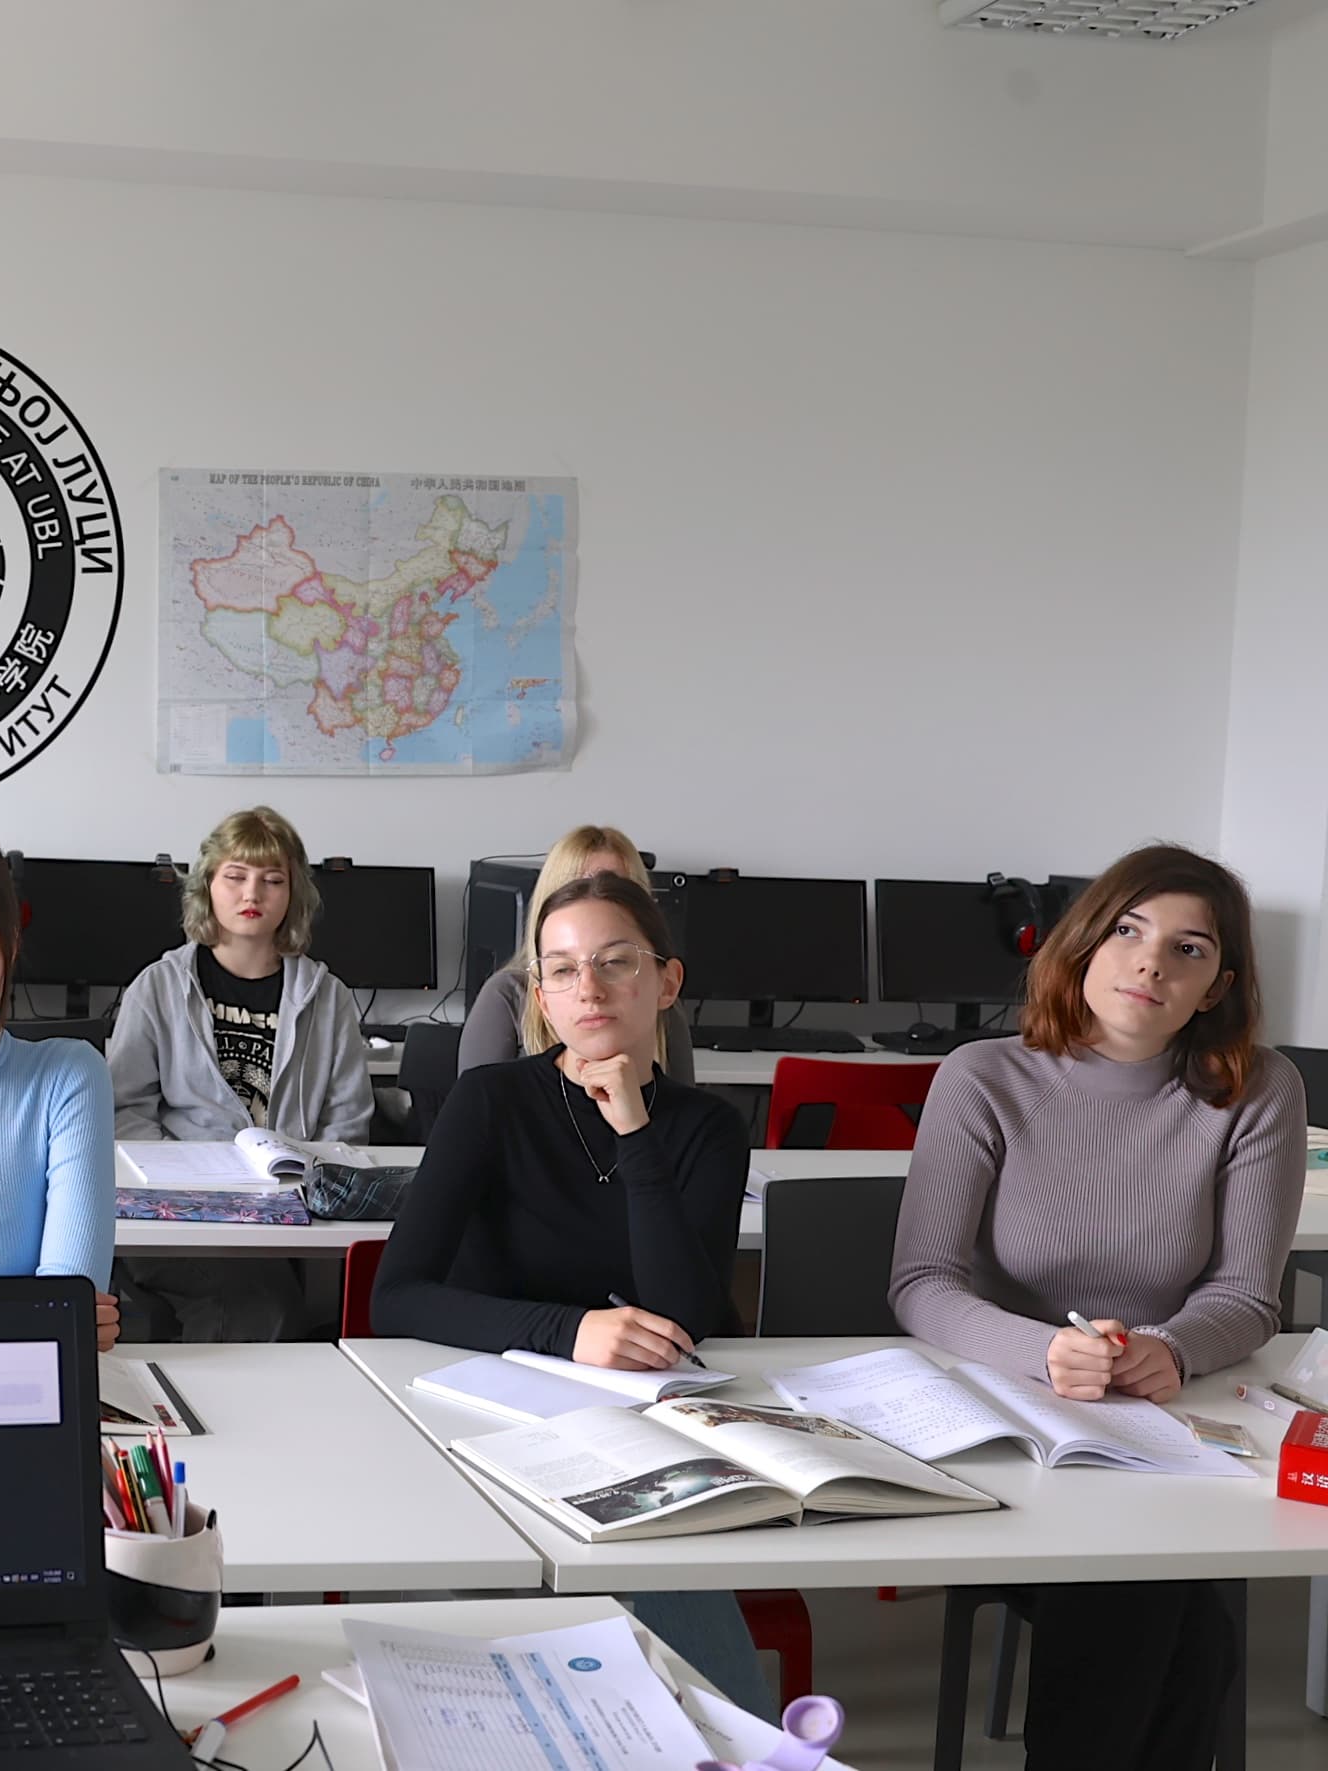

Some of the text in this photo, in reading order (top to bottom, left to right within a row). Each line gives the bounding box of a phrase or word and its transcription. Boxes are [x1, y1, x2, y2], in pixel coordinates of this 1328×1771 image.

[0, 451, 43, 488] AT
[25, 493, 63, 561] UBL
[53, 454, 113, 575] ЛУЦИ
[209, 473, 226, 484] MAP
[241, 474, 258, 485] THE
